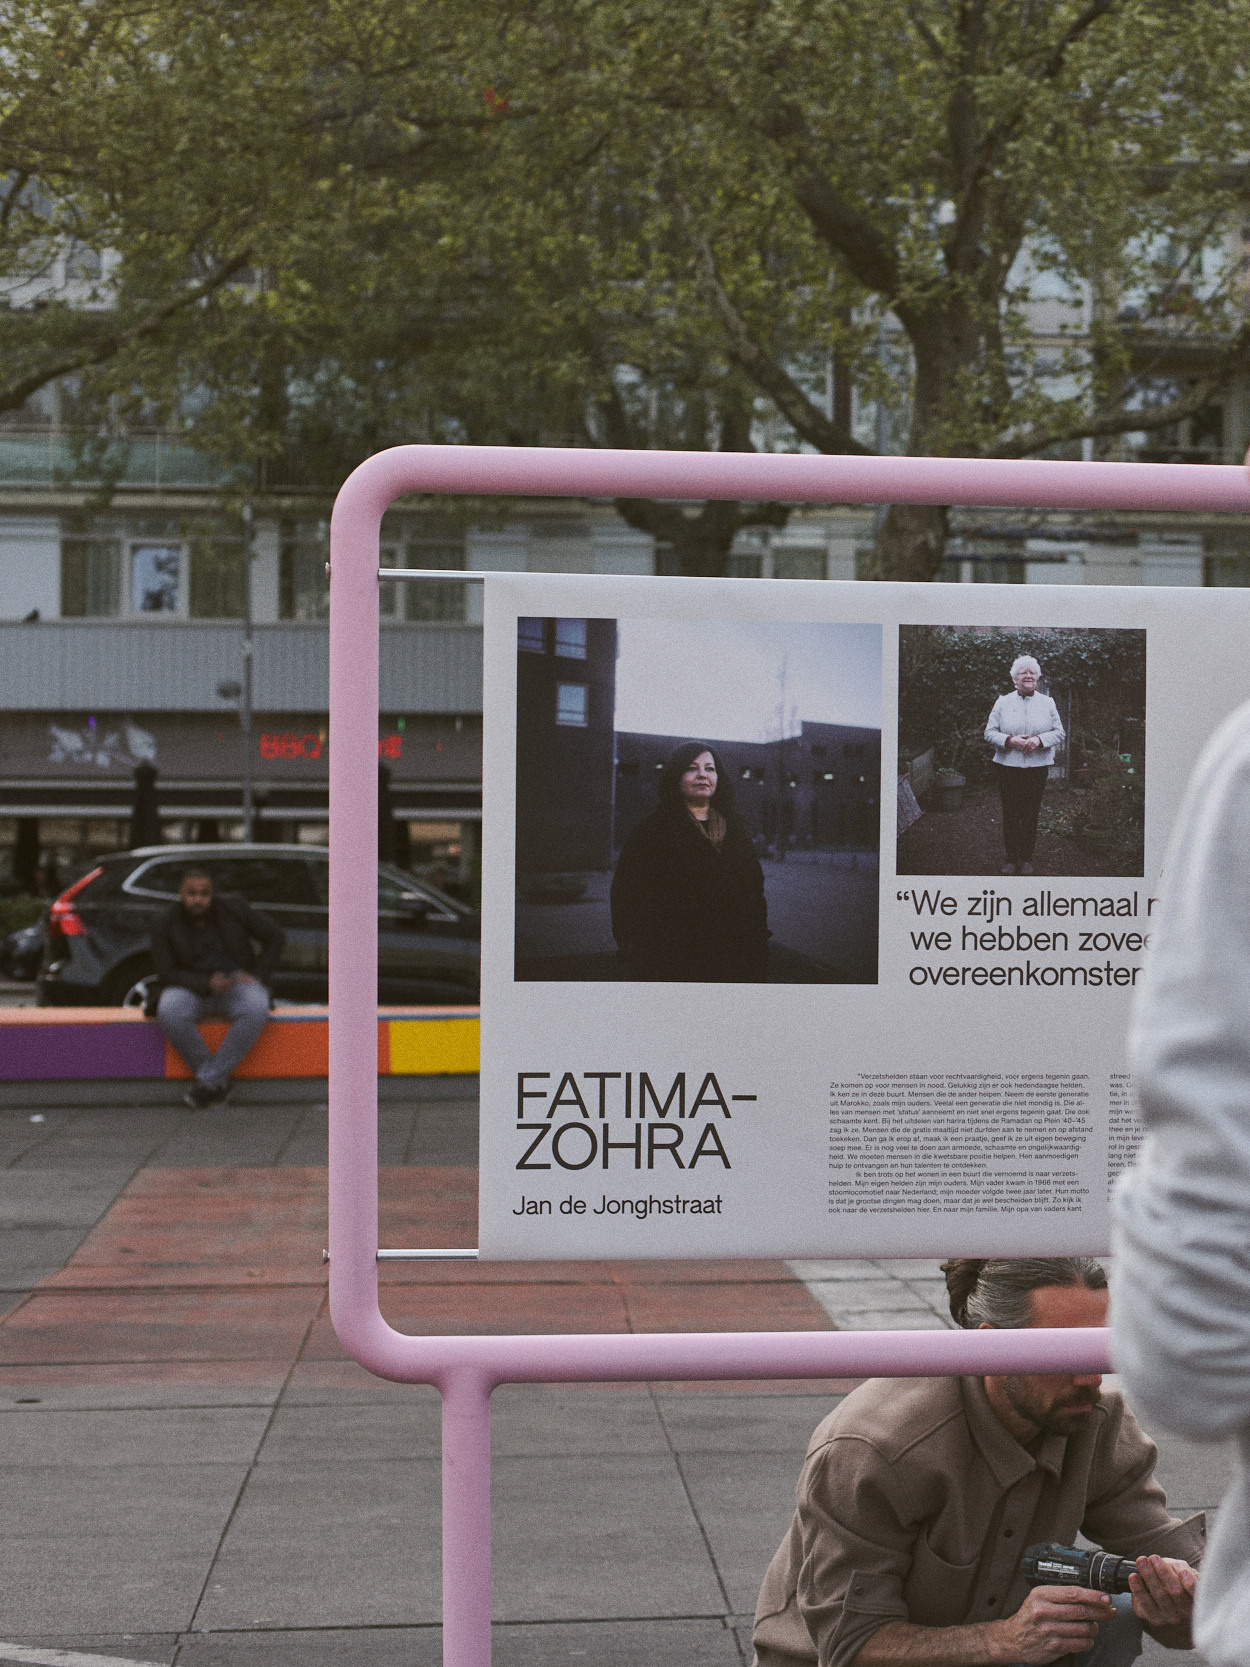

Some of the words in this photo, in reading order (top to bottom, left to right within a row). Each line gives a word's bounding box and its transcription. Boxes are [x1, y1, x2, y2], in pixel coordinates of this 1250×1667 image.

[259, 733, 322, 760] BBQ
[967, 890, 1012, 923] zijn
[1022, 891, 1138, 917] allemaal
[910, 931, 951, 951] we
[962, 926, 1068, 951] hebben
[1045, 1072, 1071, 1081] tegenin
[948, 1081, 978, 1090] Gelukkig
[979, 1081, 991, 1090] zijn
[1014, 1081, 1059, 1090] hedendaagse
[1058, 1089, 1090, 1099] generatie
[892, 1099, 906, 1108] mijn
[969, 1099, 1001, 1108] generatie
[1029, 1098, 1054, 1108] mondig
[1020, 1107, 1045, 1117] tegenin
[967, 1116, 990, 1126] tijdens
[913, 1125, 932, 1135] gratis
[933, 1125, 959, 1135] maaltijd
[991, 1134, 1007, 1143] geef
[1035, 1134, 1053, 1143] eigen
[1054, 1134, 1087, 1143] beweging
[516, 1122, 731, 1170] ZOHRA
[1028, 1142, 1082, 1152] ongelijkwaardig-
[969, 1152, 992, 1161] positie
[1035, 1151, 1079, 1161] aanmoedigen
[828, 1161, 844, 1170] hulp
[853, 1161, 889, 1170] ontvangen
[855, 1179, 869, 1188] Mijn
[871, 1179, 890, 1188] eigen
[915, 1178, 927, 1188] zijn
[929, 1178, 943, 1188] mijn
[970, 1178, 985, 1187] Mijn
[940, 1187, 954, 1196] mijn
[983, 1187, 1005, 1196] volgde
[1023, 1187, 1036, 1196] jaar
[856, 1196, 882, 1206] grootse
[883, 1196, 906, 1205] dingen
[1062, 1195, 1075, 1205] kijk
[512, 1195, 552, 1215] Jan
[559, 1195, 587, 1215] de
[593, 1195, 723, 1220] Jonghstraat
[960, 1205, 974, 1214] mijn
[1001, 1204, 1015, 1214] Mijn
